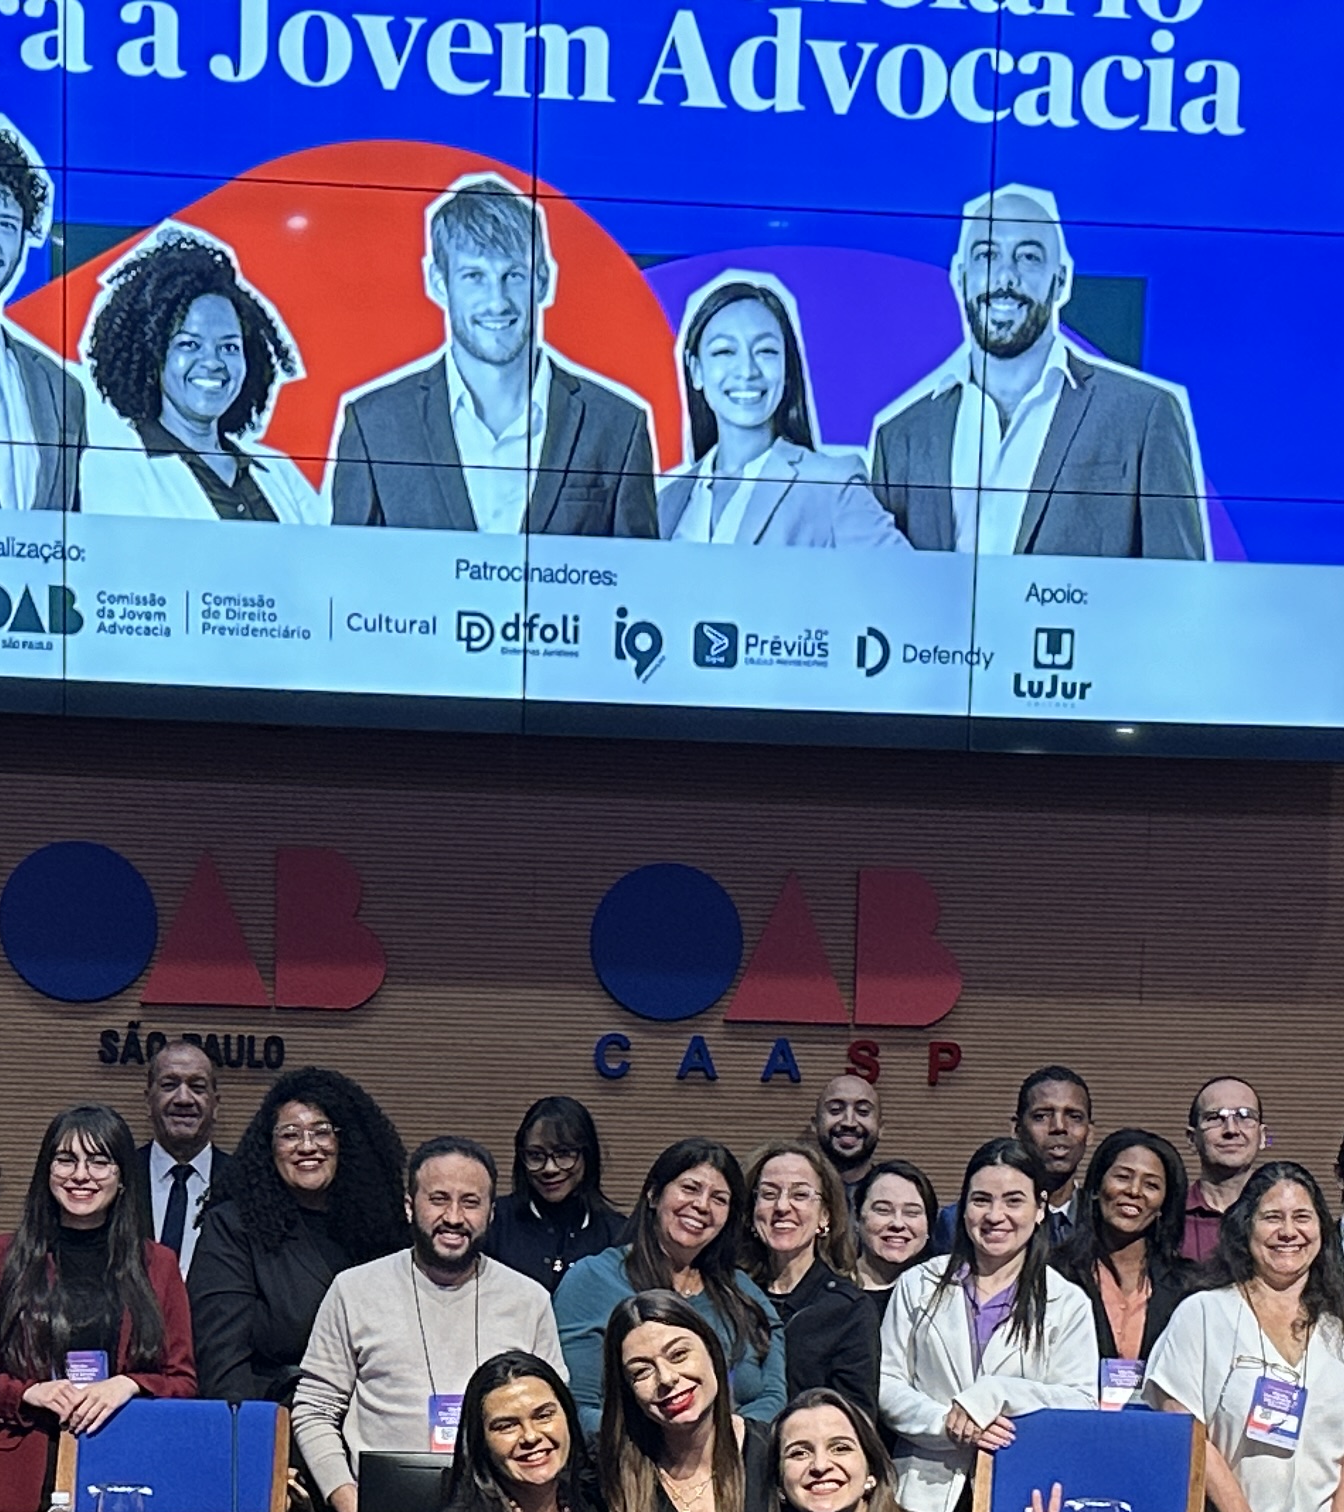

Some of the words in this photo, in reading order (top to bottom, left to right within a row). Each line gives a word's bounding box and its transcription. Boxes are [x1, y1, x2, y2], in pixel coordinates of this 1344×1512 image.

[116, 0, 187, 79] a
[209, 0, 616, 105] Jovem
[638, 8, 1246, 136] Advocacia
[455, 559, 619, 587] Patrocinadores:
[96, 590, 167, 607] Comissão
[201, 592, 276, 608] Comissão
[1025, 582, 1089, 606] Apoio:
[96, 607, 115, 620] da
[118, 607, 167, 623] Jovem
[201, 607, 221, 621] de
[226, 607, 278, 623] Direito
[346, 613, 438, 636] Cultural
[96, 622, 172, 638] Advocacia
[201, 623, 312, 641] Previdenciário
[501, 613, 580, 646] dfoli
[902, 644, 996, 671] Defendy
[1013, 672, 1092, 700] LuJur
[589, 862, 963, 1028] OAB
